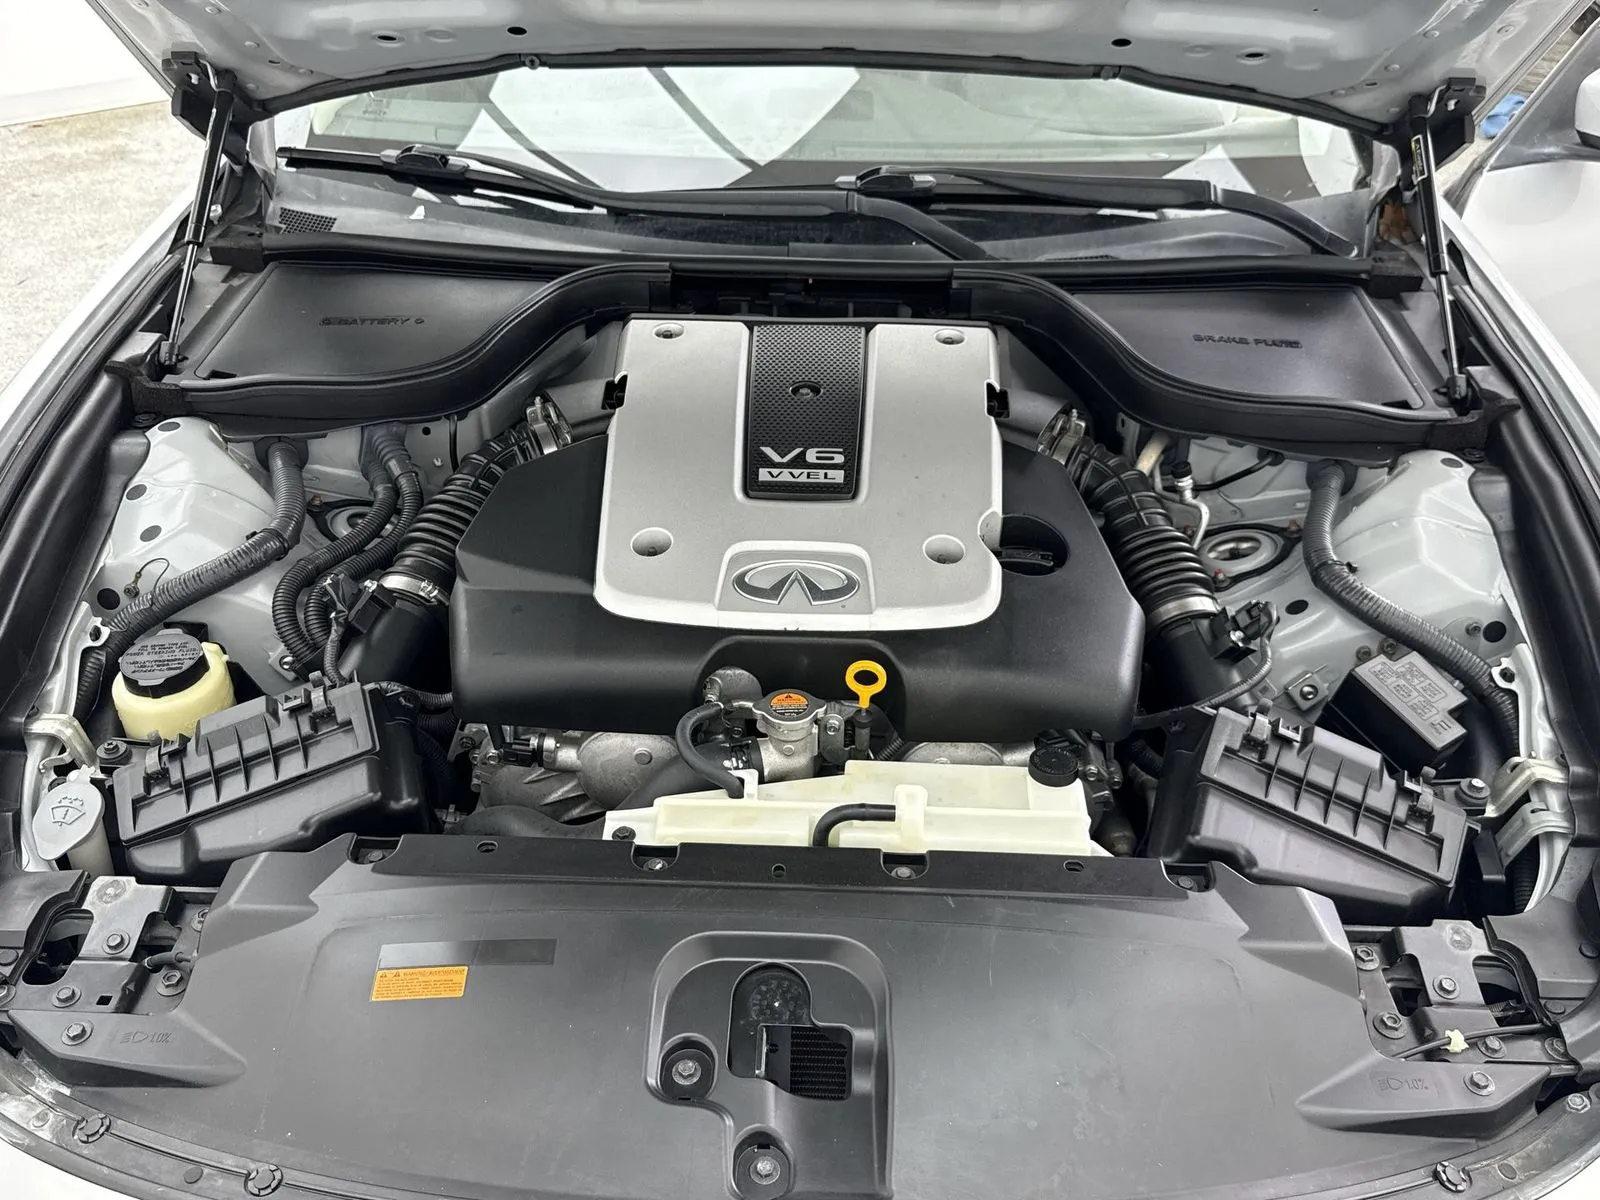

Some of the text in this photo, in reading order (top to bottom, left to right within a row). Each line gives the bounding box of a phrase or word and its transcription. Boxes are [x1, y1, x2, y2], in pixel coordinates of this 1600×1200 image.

[338, 317, 410, 326] BATTERY
[1192, 334, 1250, 345] BRAKE
[760, 446, 845, 464] V6
[767, 470, 836, 480] VVEL
